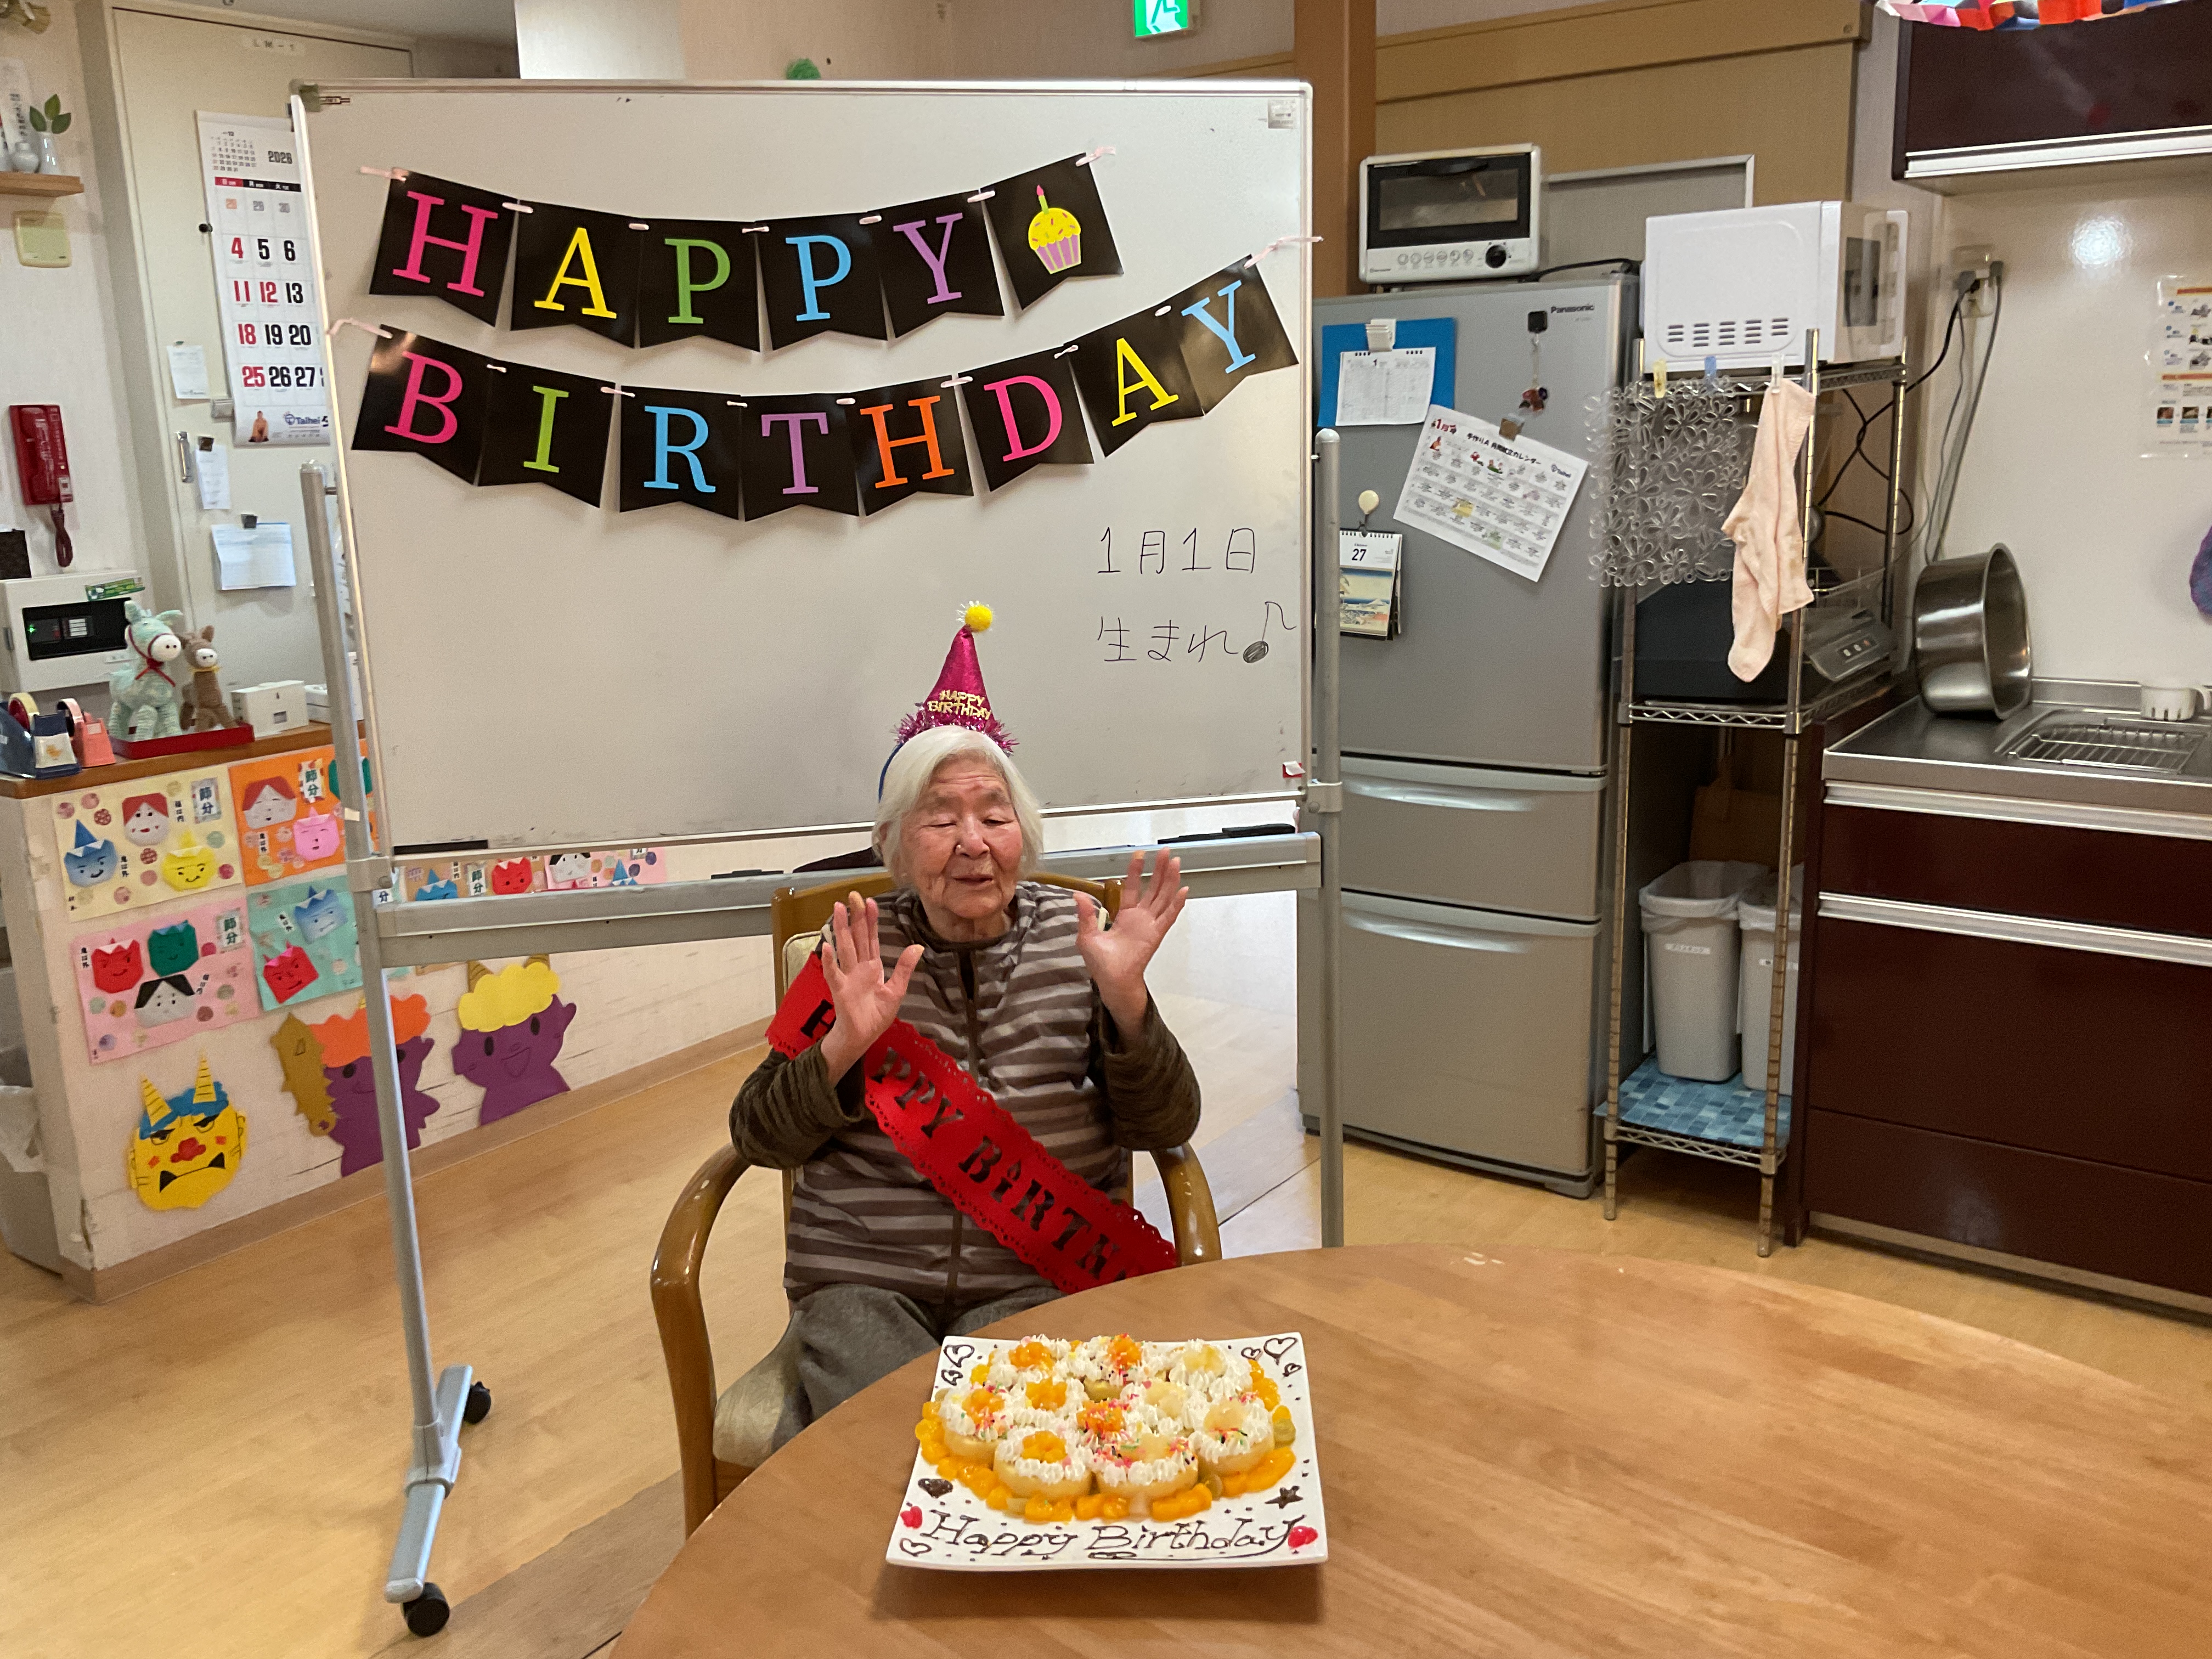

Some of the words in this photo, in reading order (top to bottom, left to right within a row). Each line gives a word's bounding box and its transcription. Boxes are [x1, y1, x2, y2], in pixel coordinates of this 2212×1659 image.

[231, 237, 243, 258] 4
[257, 239, 270, 259] 5
[284, 240, 296, 261] 6
[393, 190, 963, 324] HAPPY
[234, 280, 250, 302] 11
[259, 281, 278, 303] 12
[285, 283, 303, 303] 13
[1551, 303, 1594, 313] Panasonic
[238, 324, 256, 345] 18
[265, 324, 283, 345] 19
[289, 324, 311, 345] 20
[242, 366, 265, 387] 25
[269, 366, 291, 387] 26
[295, 366, 315, 387] 27
[385, 280, 1256, 494] BIRTHDAY
[296, 416, 320, 425] Taihei
[1098, 527, 1256, 574] 1月1日
[1351, 549, 1367, 561] 27
[939, 690, 986, 707] HAPPY
[927, 701, 992, 720] BIRTHDAY
[920, 1509, 1078, 1556] Happy
[1084, 1514, 1306, 1561] Birthday
